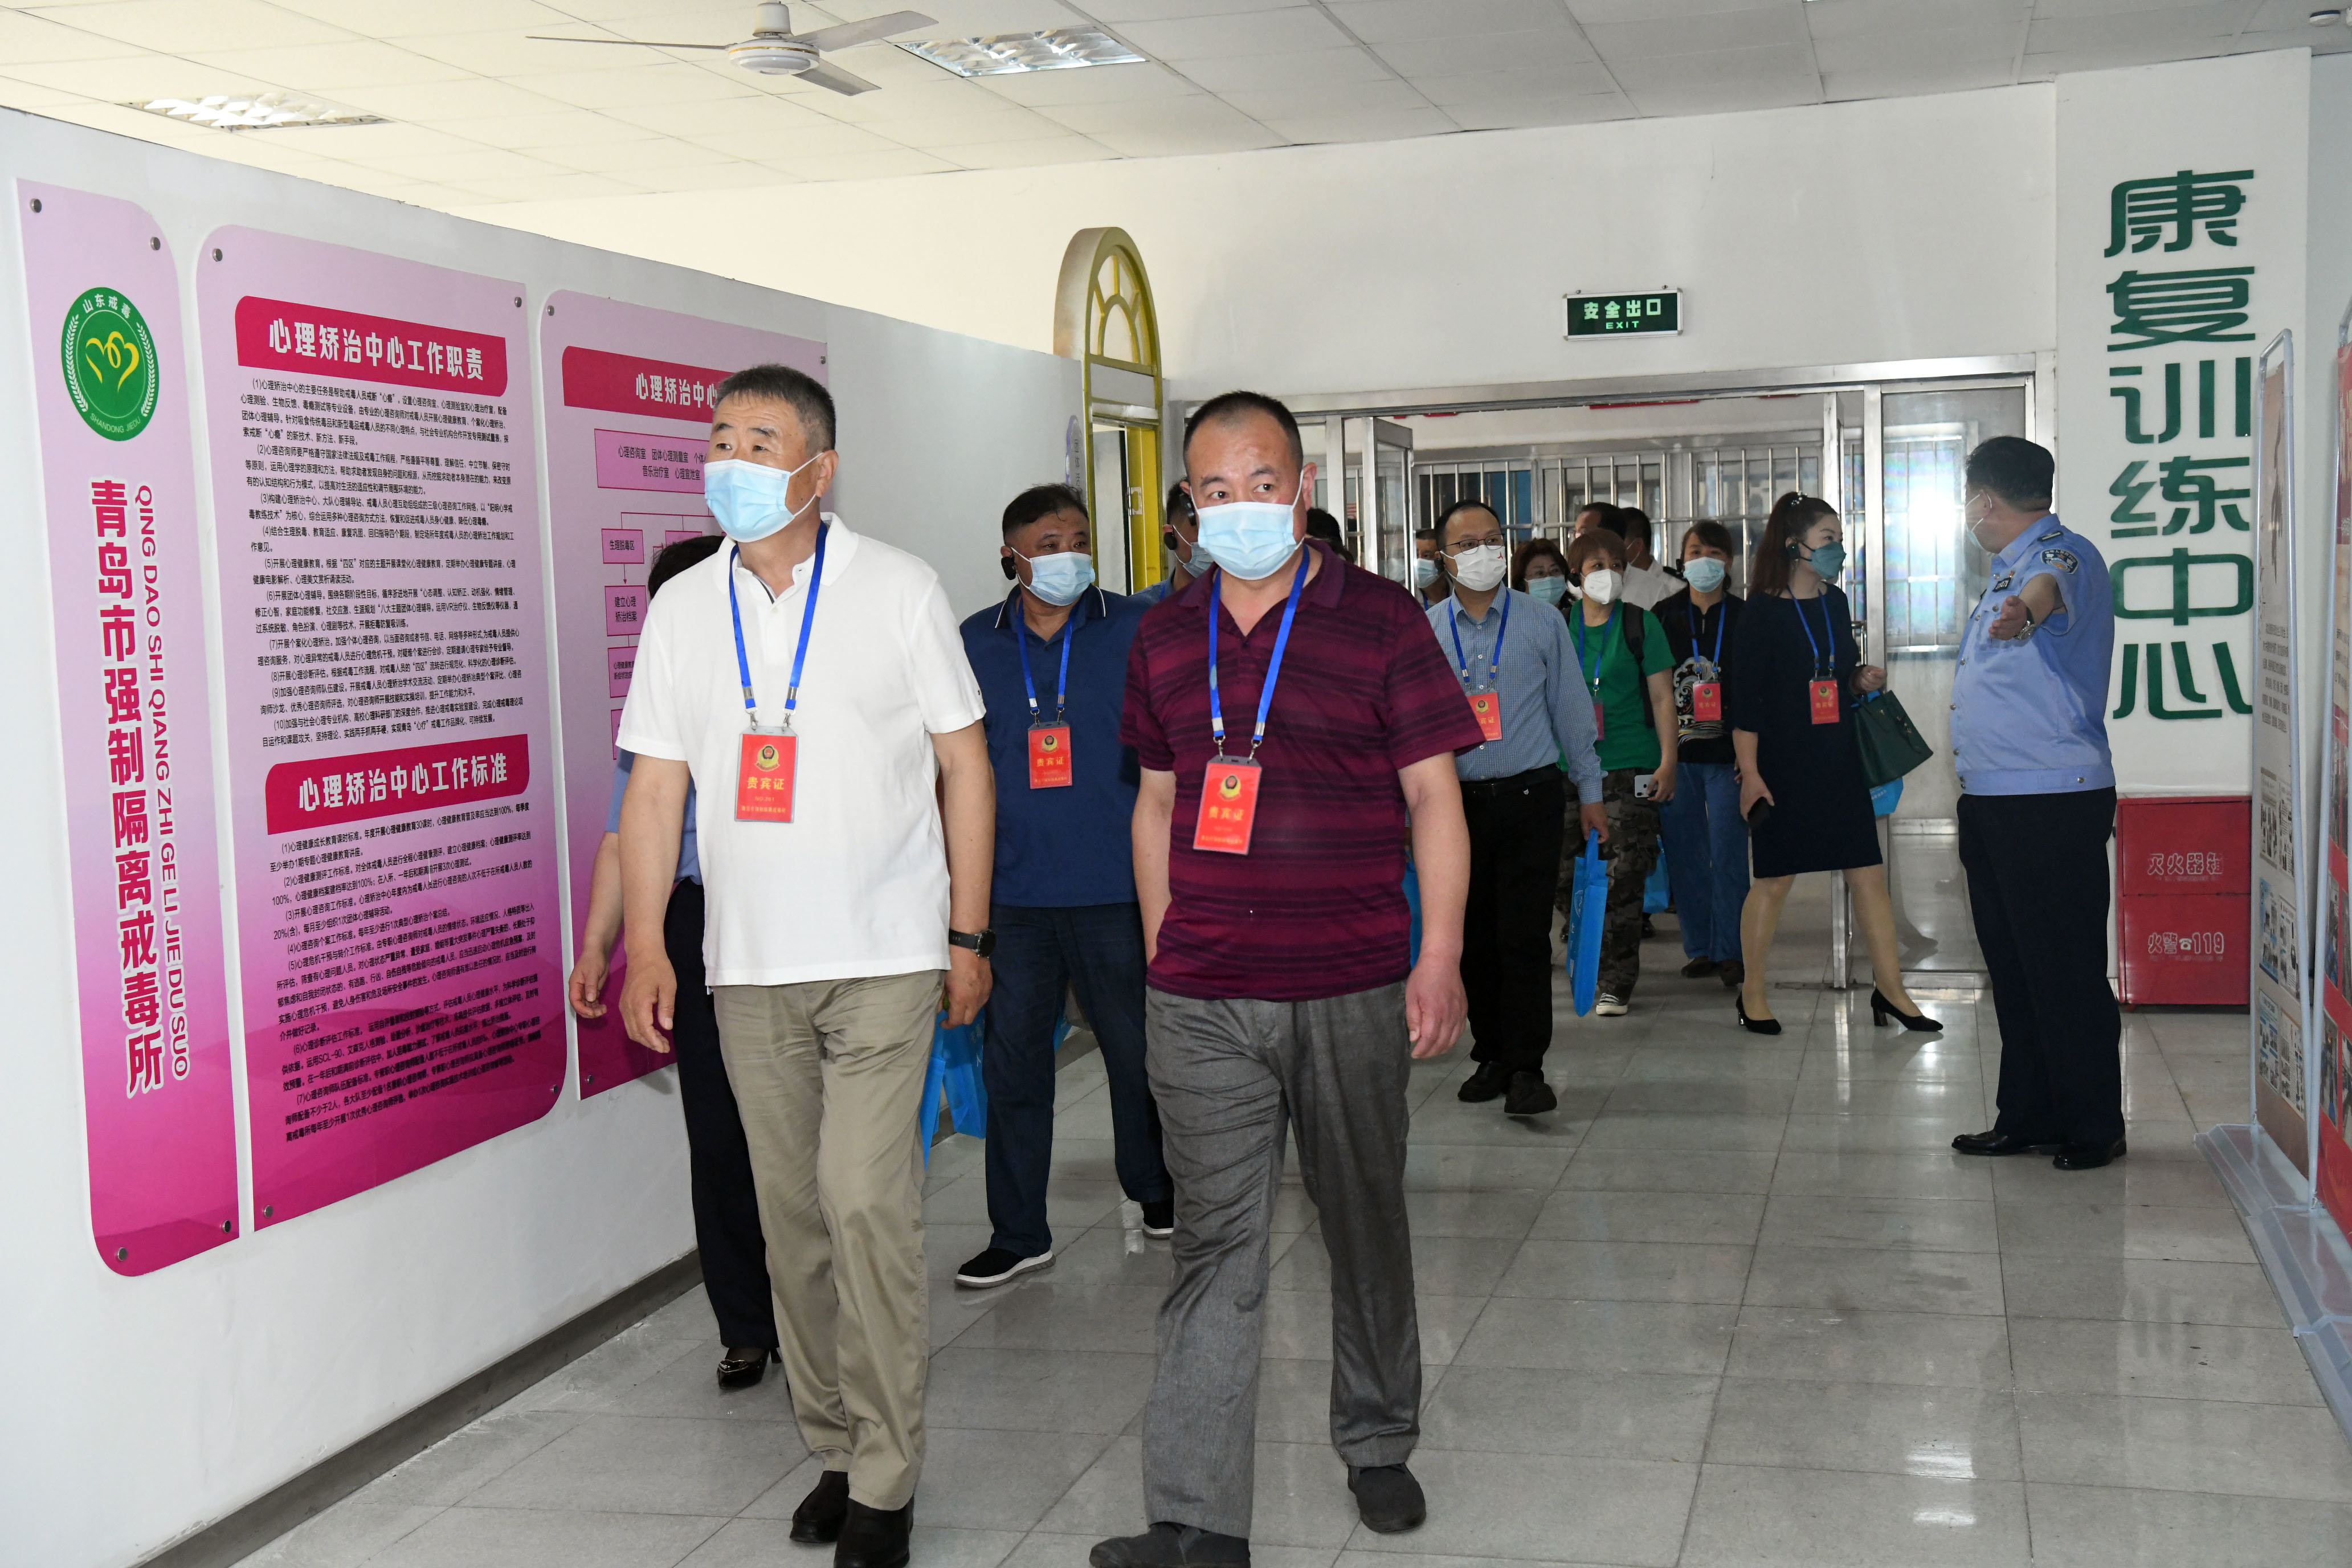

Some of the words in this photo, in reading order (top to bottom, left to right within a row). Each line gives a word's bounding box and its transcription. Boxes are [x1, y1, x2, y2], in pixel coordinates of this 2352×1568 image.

[82, 293, 131, 318] 山东戒毒
[1584, 299, 1661, 320] 安全出口
[1606, 321, 1639, 329] EXIT
[269, 318, 483, 381] 心理矫治中心工作职责
[635, 373, 717, 409] 心理矫治中心
[90, 413, 124, 433] SHANDONG
[126, 416, 141, 432] JIEDU
[618, 445, 646, 459] 心理咨询室
[652, 449, 688, 463] 团体心理测量室
[2104, 169, 2256, 722] 康复训练中心
[643, 465, 669, 478] 音乐治疗室
[675, 468, 700, 480] 心理宣泄室
[135, 485, 156, 557] QING
[250, 541, 273, 552] 作意见。
[610, 540, 635, 550] 生理脱毒区
[144, 565, 160, 627] DAO
[615, 596, 636, 607] 建立心理
[615, 611, 637, 622] 矫治档案
[148, 635, 164, 681] SHI
[148, 689, 169, 781] QIANG
[91, 480, 162, 1094] 青岛市强制隔离戒毒所
[299, 753, 507, 811] 心理矫治中心工作标准
[748, 777, 784, 790] 贵宾证
[157, 787, 173, 835] ZHI
[161, 843, 176, 880] GE
[164, 888, 178, 912] LI
[165, 920, 181, 963] JIE
[2148, 932, 2178, 954] 火警
[2192, 932, 2224, 954] 119
[168, 968, 183, 1008] DU
[172, 1016, 187, 1077] SUO
